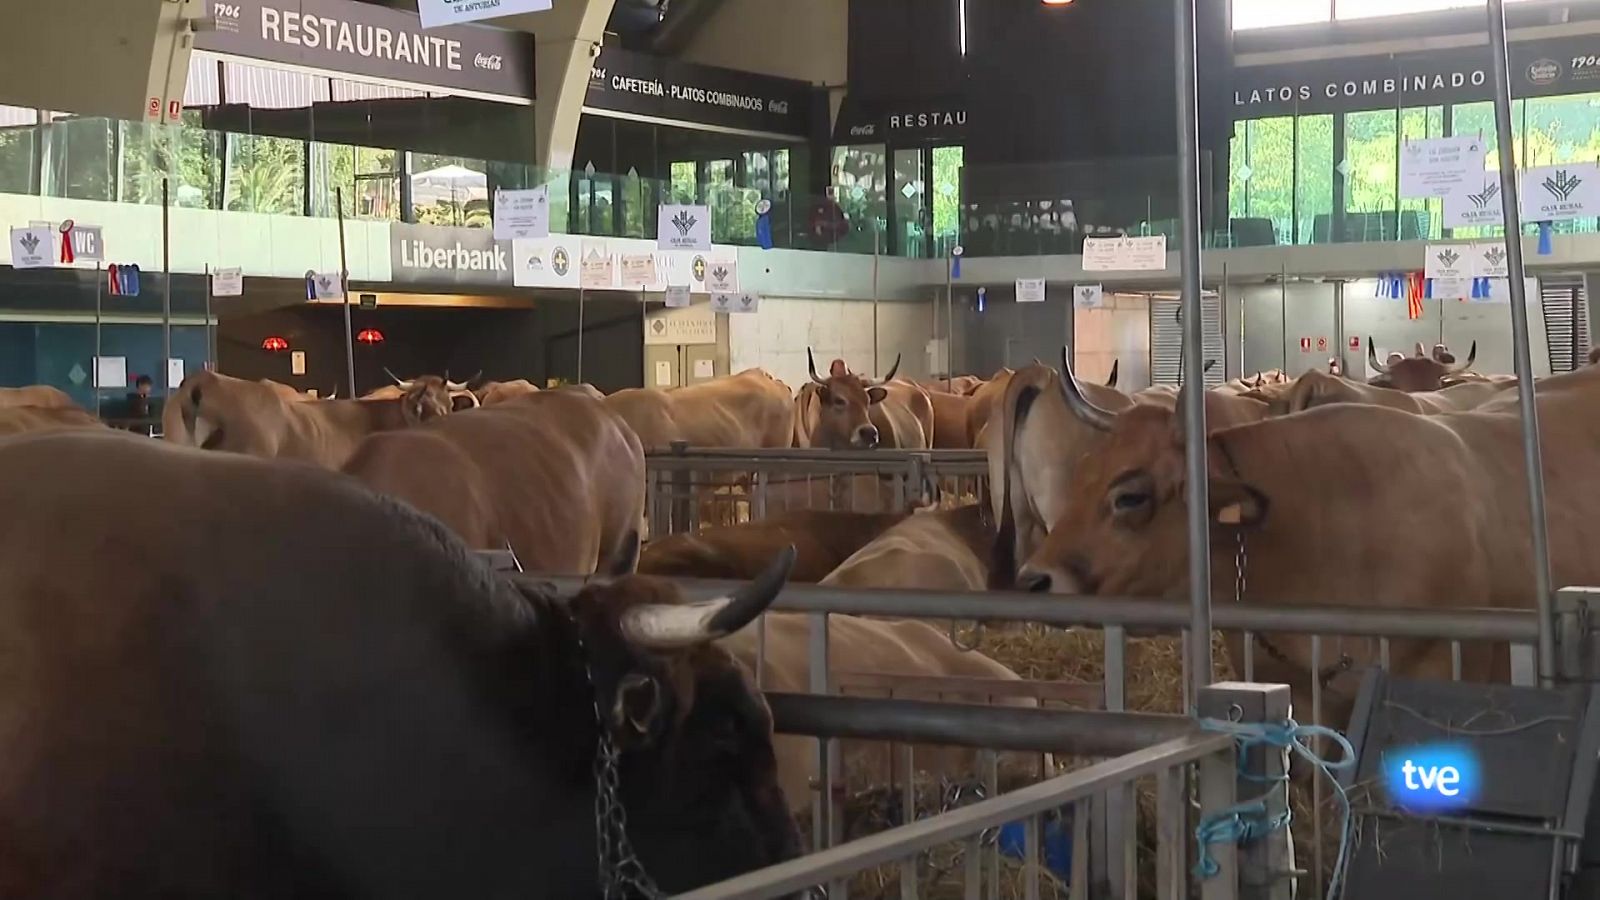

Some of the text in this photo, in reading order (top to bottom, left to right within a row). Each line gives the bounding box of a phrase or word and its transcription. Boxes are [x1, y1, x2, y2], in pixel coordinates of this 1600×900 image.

[214, 3, 240, 18] 1906
[260, 6, 462, 71] RESTAURANTE
[611, 75, 664, 97] CAFETERÍA
[671, 85, 706, 103] PLATOS
[706, 90, 763, 112] COMBINADOS
[74, 231, 95, 254] WC
[401, 239, 507, 271] Liberbank
